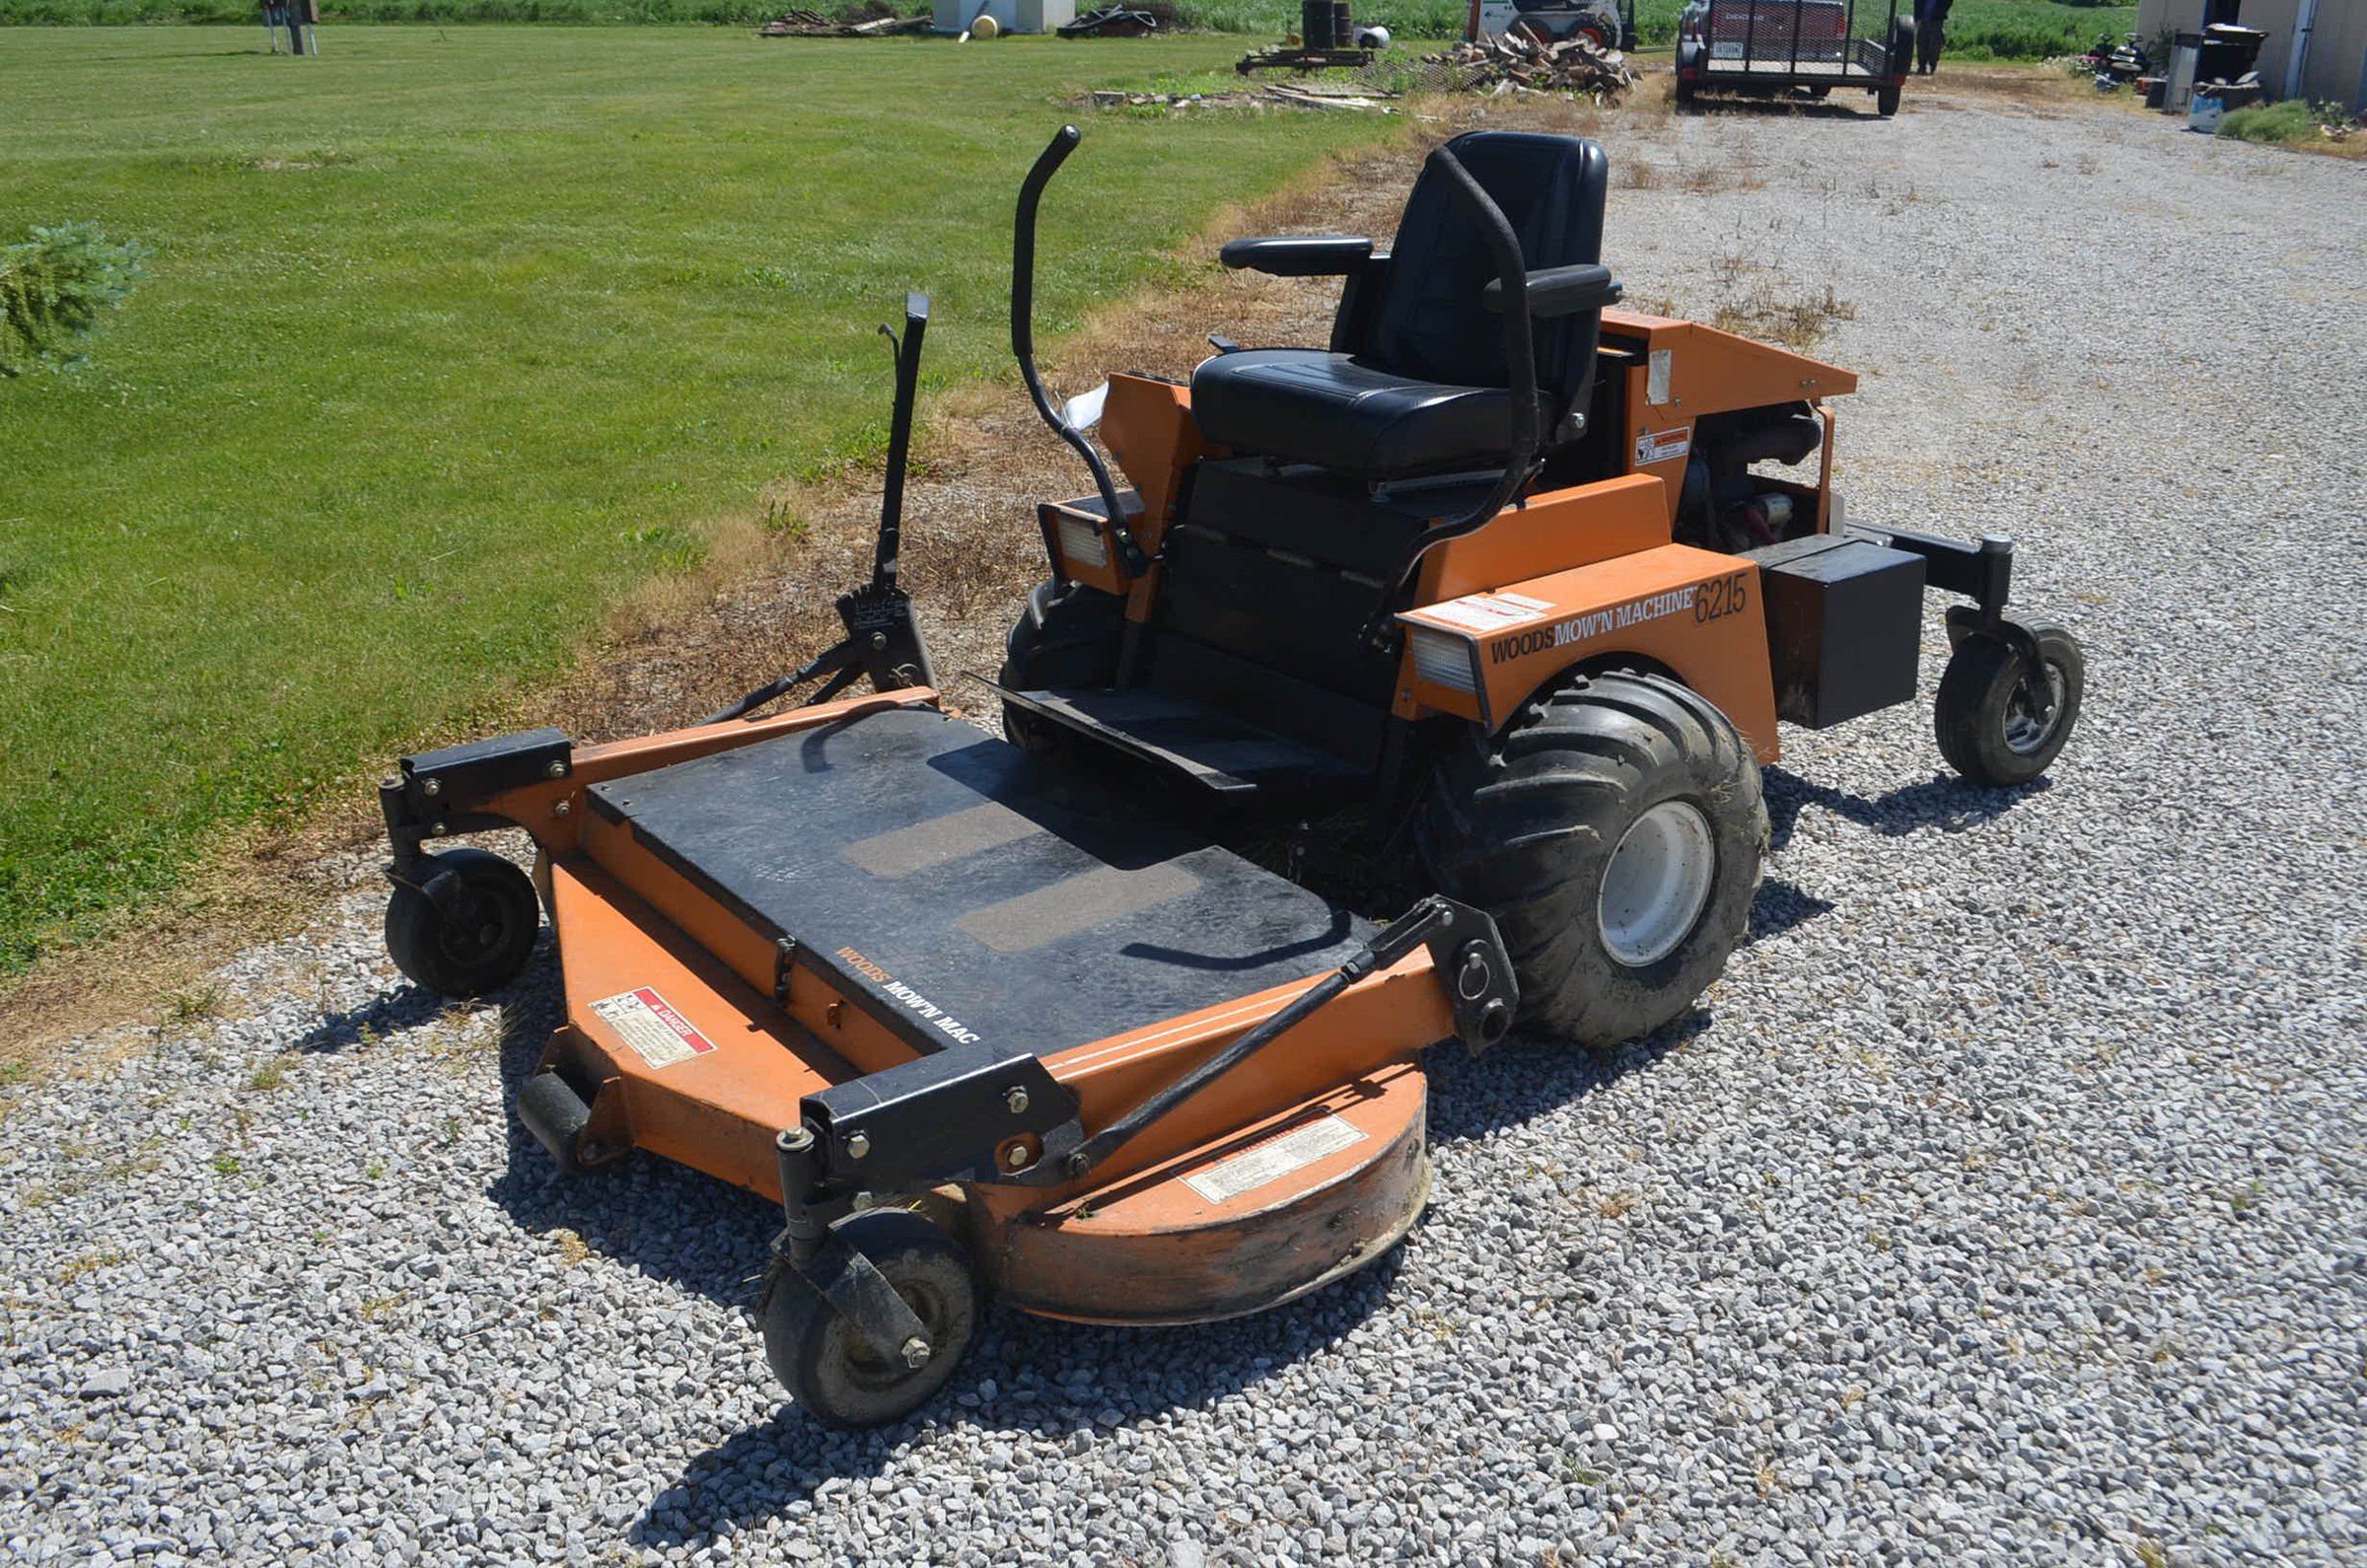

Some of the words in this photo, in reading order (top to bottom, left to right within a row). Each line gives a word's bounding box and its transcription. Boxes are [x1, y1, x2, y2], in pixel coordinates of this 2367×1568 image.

[1491, 625, 1555, 665] WOODS
[1554, 608, 1614, 647] MOW'N
[1615, 587, 1696, 629] MACHINE
[1694, 572, 1748, 623] 6215
[657, 1009, 694, 1037] DANGER
[837, 946, 894, 983] WOODS
[933, 1015, 981, 1044] MAC
